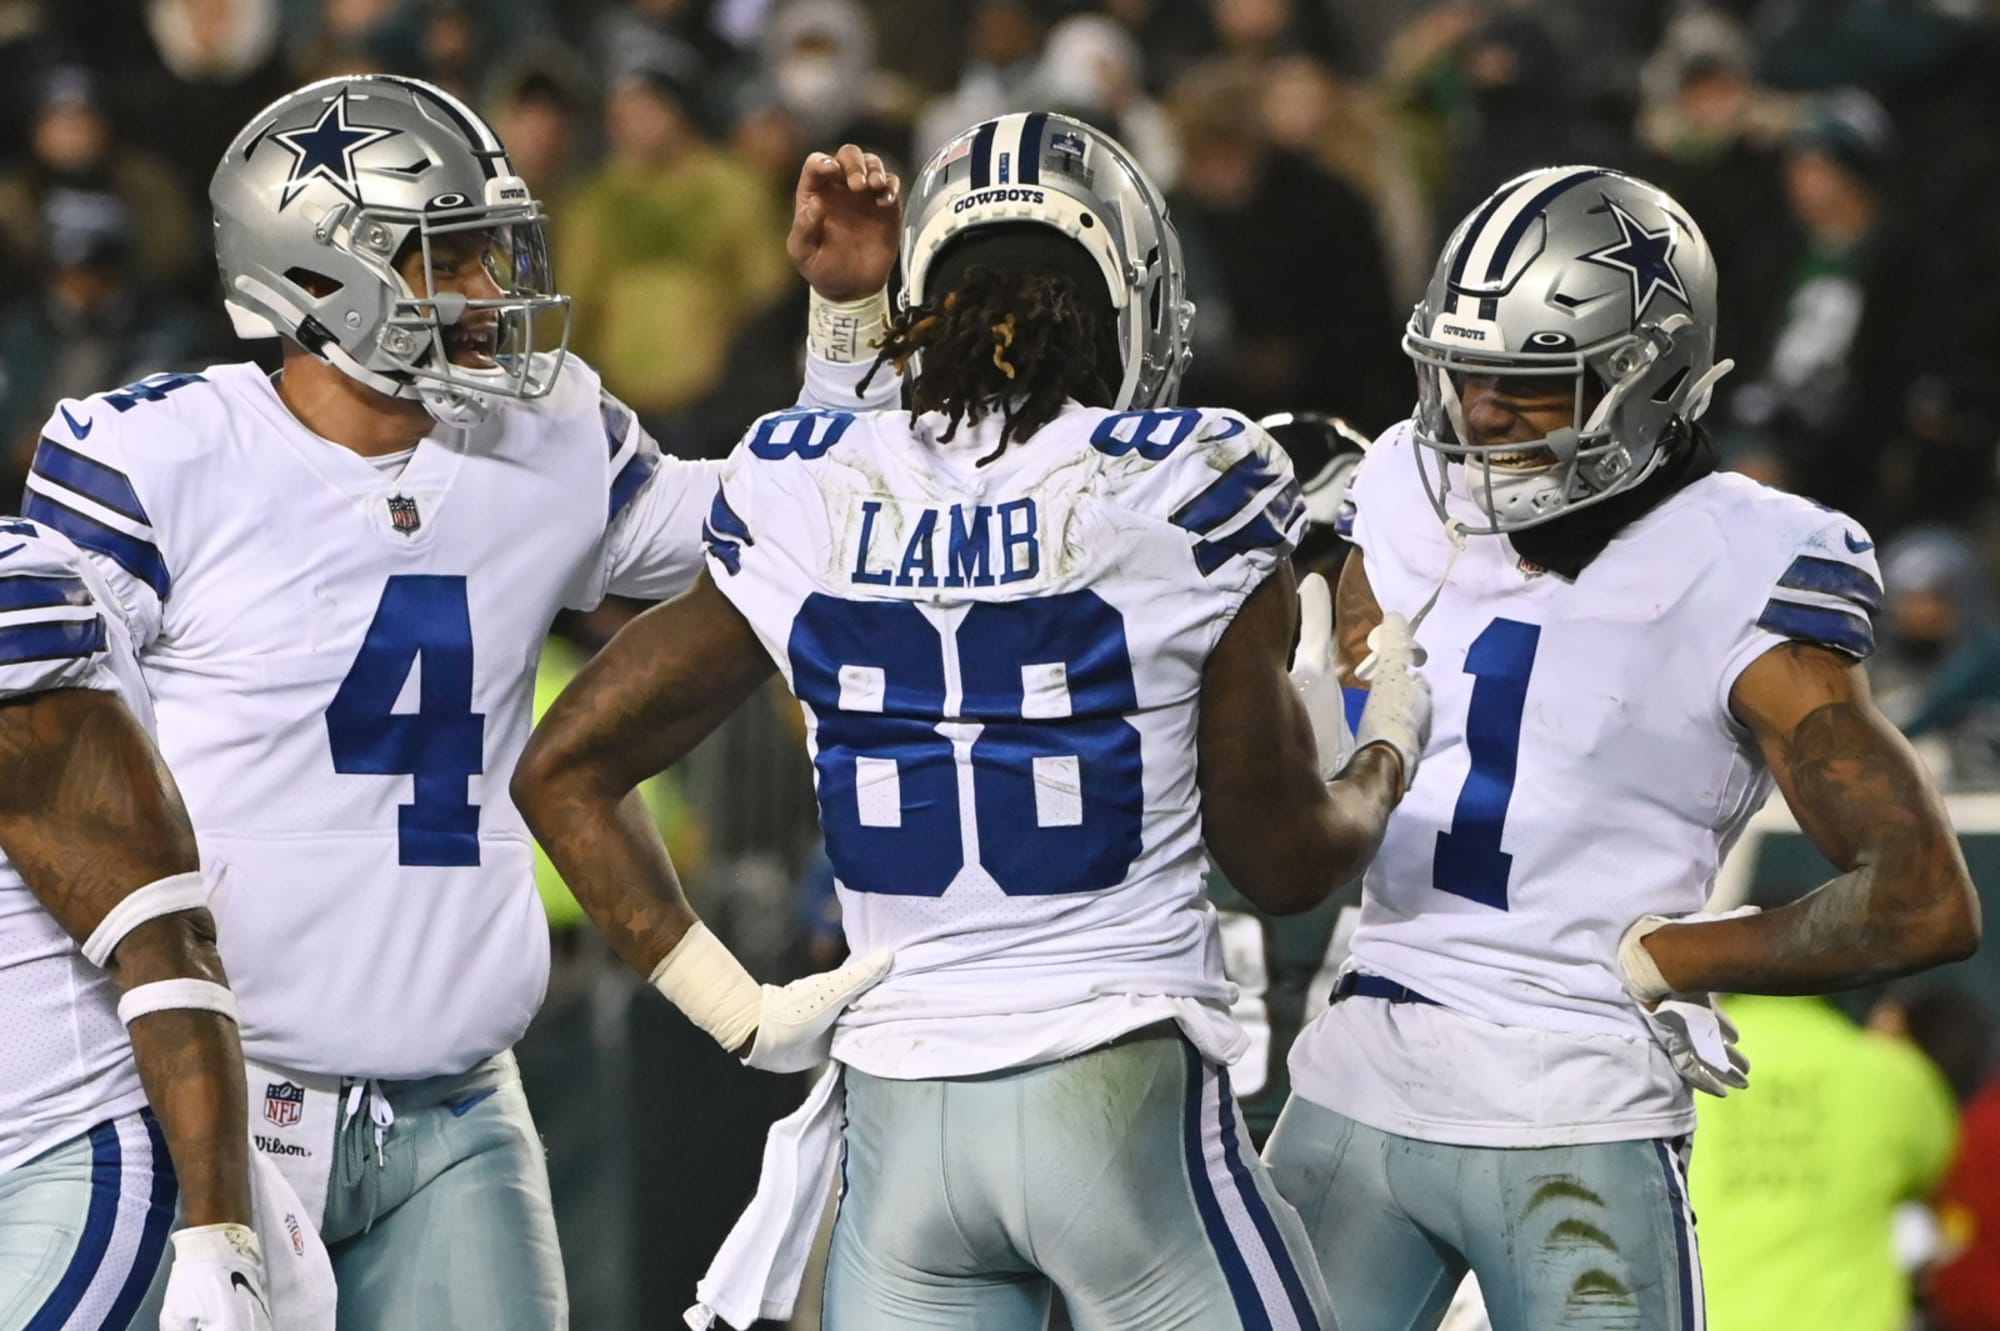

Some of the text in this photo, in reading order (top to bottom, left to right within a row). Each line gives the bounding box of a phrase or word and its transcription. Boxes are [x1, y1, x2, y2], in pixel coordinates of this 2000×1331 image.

[954, 190, 1045, 215] COWBOYS
[825, 315, 853, 364] FAITH
[852, 497, 1040, 588] LAMB
[325, 574, 486, 868] 4
[788, 588, 1144, 898] 88
[1433, 616, 1542, 912] 1
[267, 1099, 299, 1124] NFL
